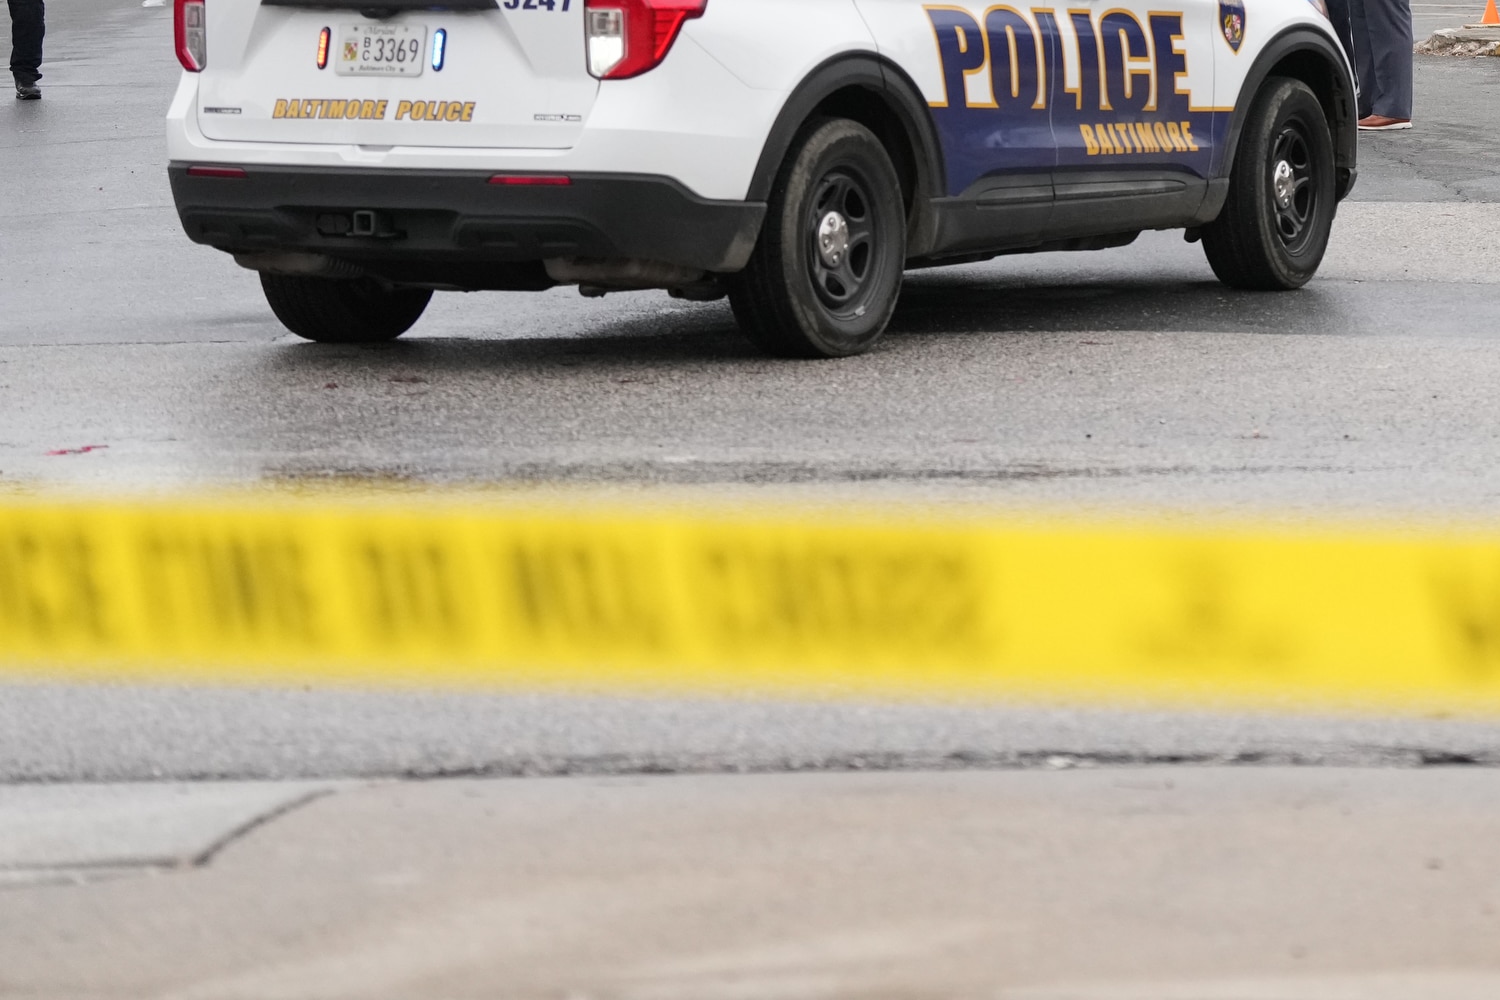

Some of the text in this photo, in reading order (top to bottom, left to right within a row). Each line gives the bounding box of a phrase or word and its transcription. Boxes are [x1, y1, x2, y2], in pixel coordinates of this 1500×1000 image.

[374, 38, 418, 62] 3369
[922, 4, 1191, 112] POLICE
[272, 99, 476, 122] BALTIMORE POLICE
[1079, 122, 1199, 155] BALTIMORE
